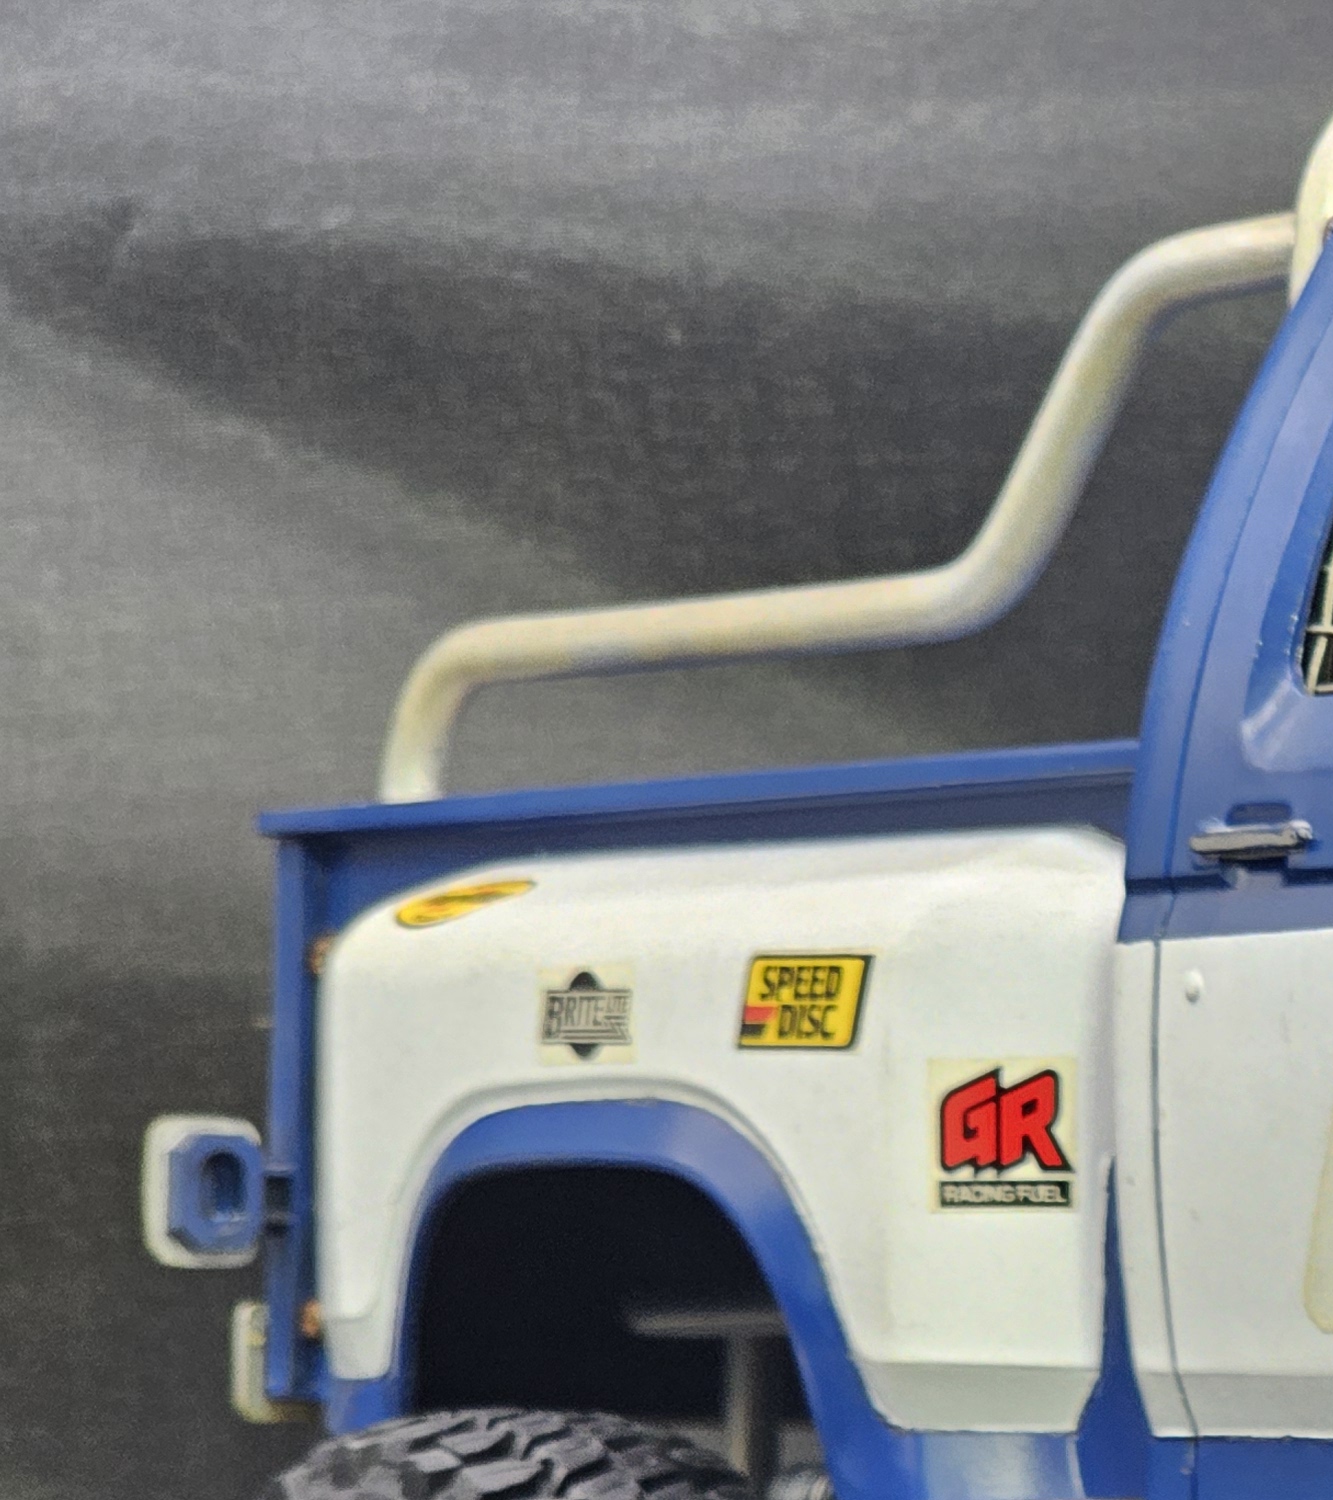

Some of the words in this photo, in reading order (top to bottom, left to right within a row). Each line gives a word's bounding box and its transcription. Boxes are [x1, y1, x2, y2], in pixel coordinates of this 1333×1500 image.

[759, 965, 844, 1001] SPEED
[778, 1004, 838, 1040] DISC
[941, 1067, 1073, 1175] GR
